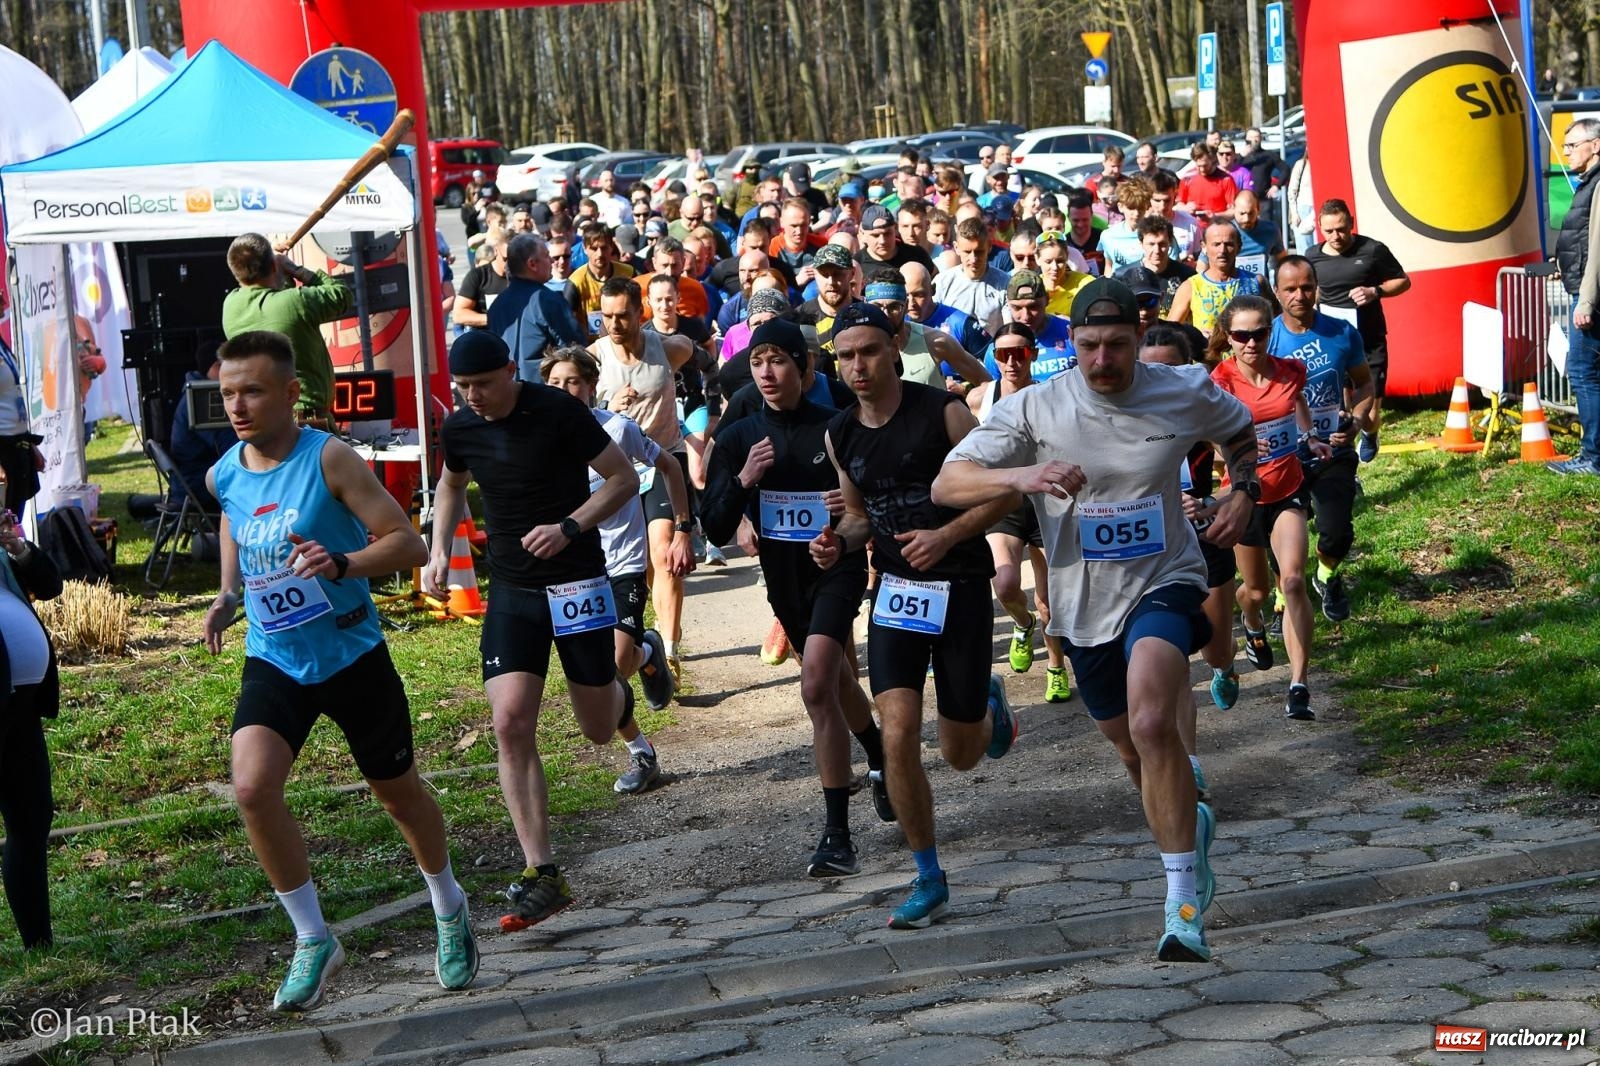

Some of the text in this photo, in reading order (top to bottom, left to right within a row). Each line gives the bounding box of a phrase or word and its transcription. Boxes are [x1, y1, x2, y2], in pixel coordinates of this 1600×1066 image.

[1270, 9, 1280, 48] P
[1201, 38, 1213, 74] P
[33, 194, 178, 219] PersonalBest
[345, 194, 381, 205] MITKO
[333, 381, 375, 413] 02
[1268, 431, 1290, 450] 63
[236, 508, 299, 547] NEVER
[776, 509, 812, 527] 110
[1095, 519, 1149, 546] 055
[261, 587, 305, 615] 120
[562, 596, 606, 620] 043
[888, 593, 930, 618] 051
